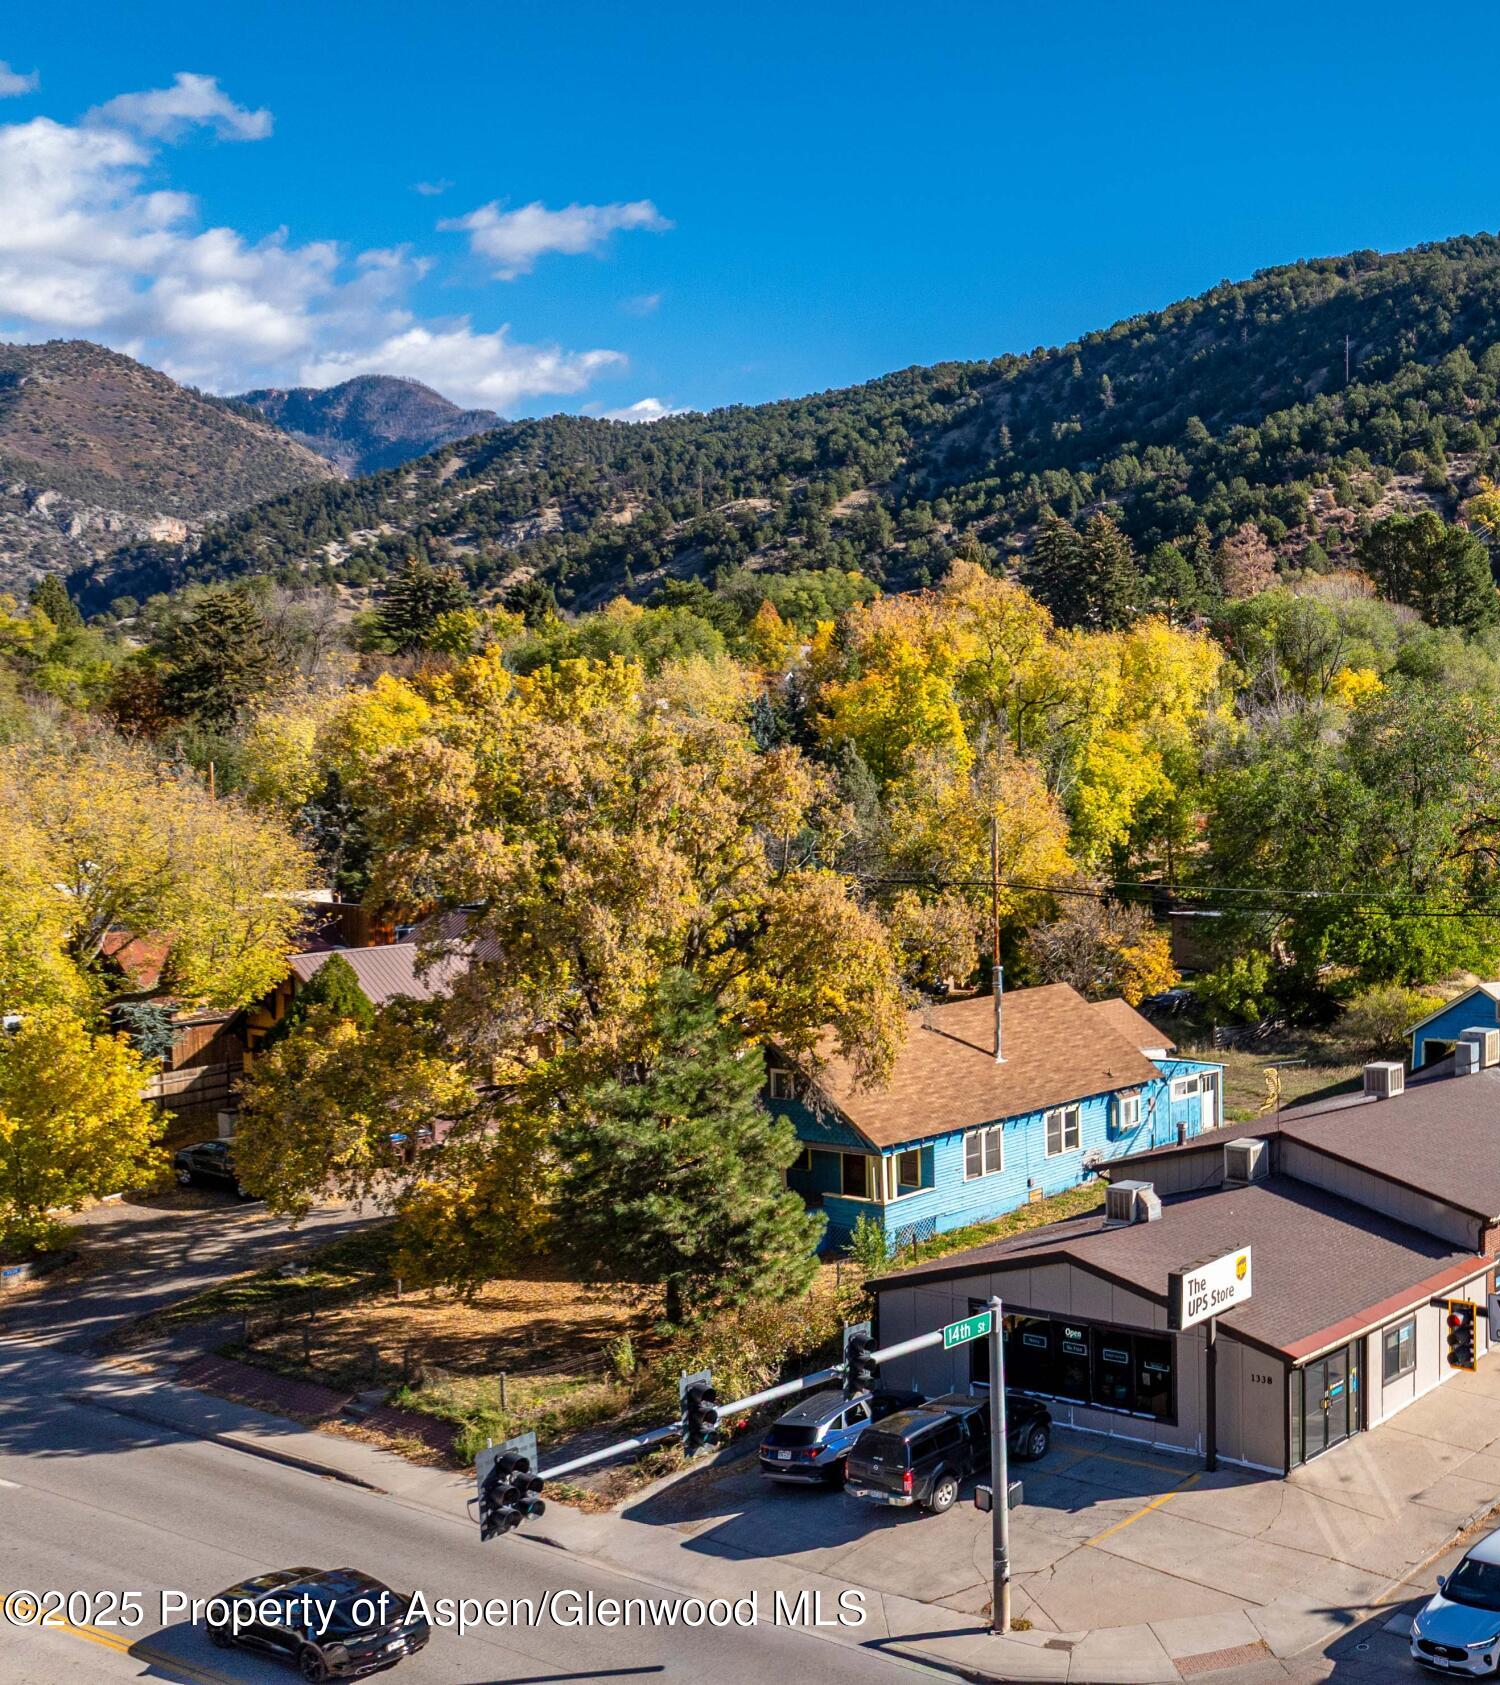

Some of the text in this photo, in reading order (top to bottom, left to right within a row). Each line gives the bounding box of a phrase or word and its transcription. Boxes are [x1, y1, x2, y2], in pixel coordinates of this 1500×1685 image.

[1188, 1278, 1206, 1296] The
[1188, 1285, 1235, 1317] UPS Store
[948, 1321, 986, 1344] 14th St
[1065, 1327, 1082, 1340] Open
[1251, 1373, 1273, 1385] 1338
